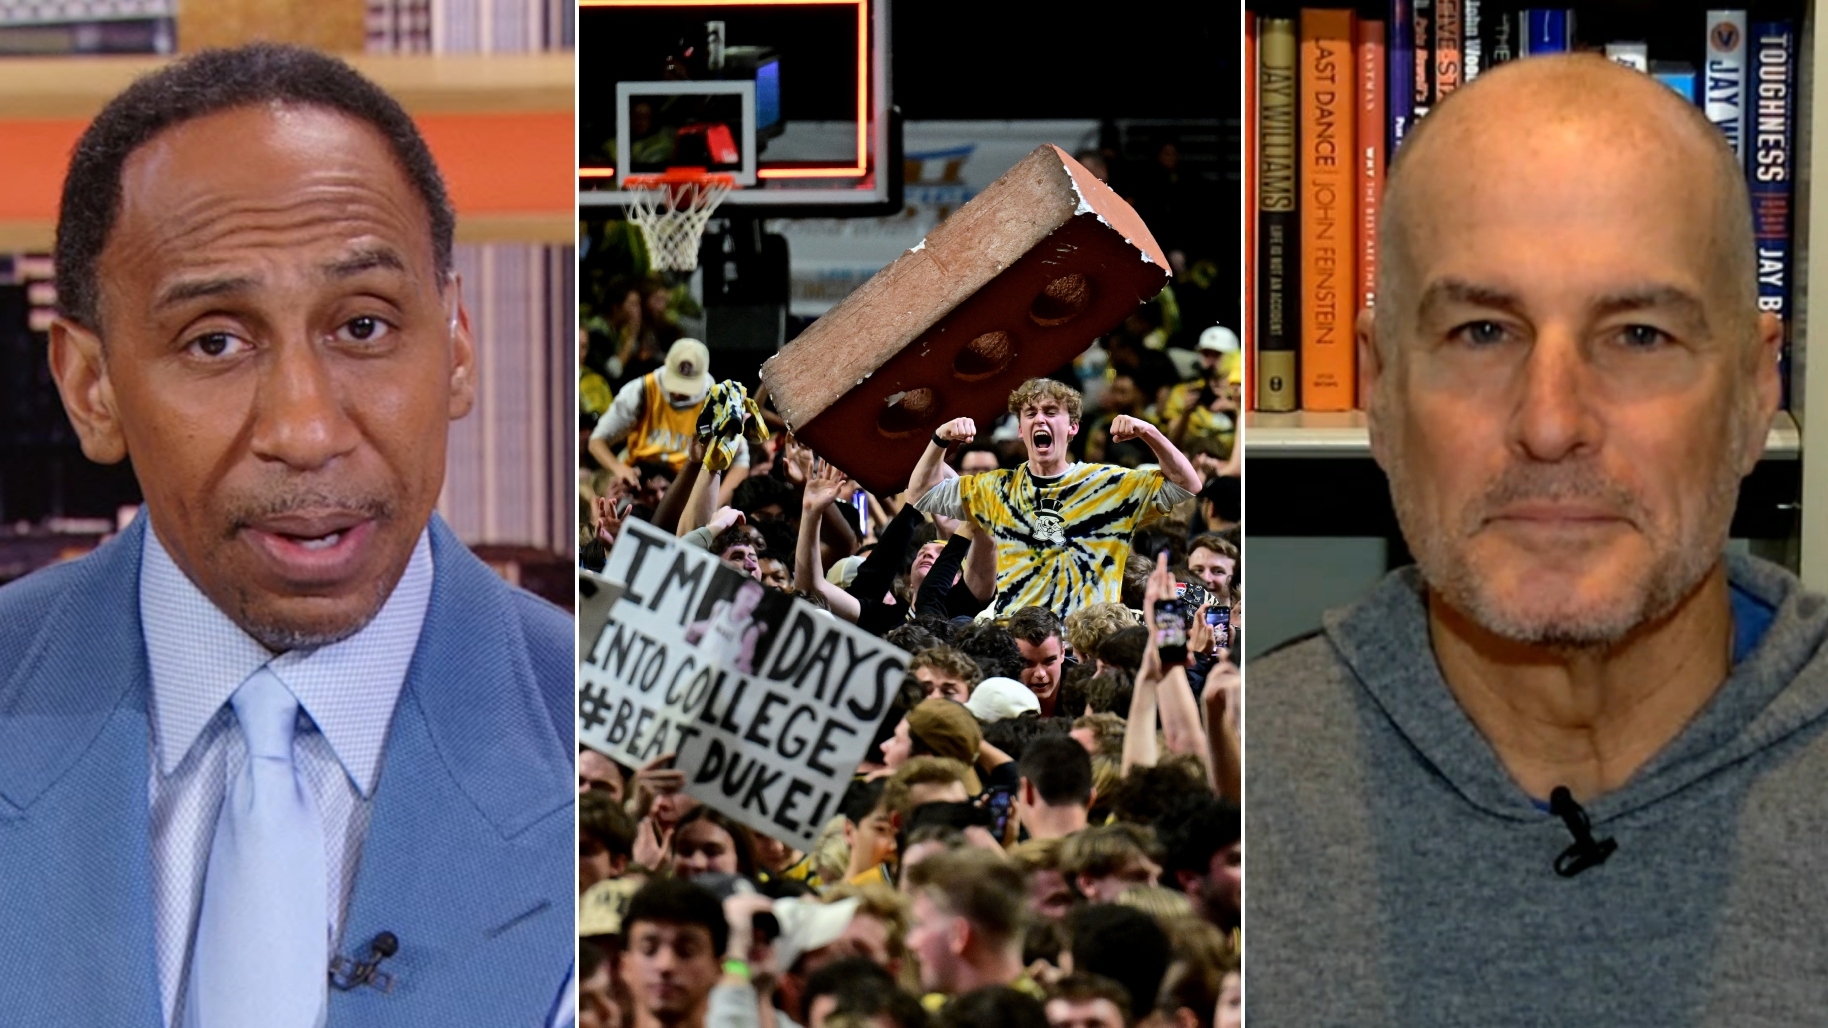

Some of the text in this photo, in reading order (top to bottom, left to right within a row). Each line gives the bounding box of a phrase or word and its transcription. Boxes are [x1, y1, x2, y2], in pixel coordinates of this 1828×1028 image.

[1709, 60, 1739, 107] JAY
[1757, 32, 1788, 182] TOUGHNESS
[1262, 63, 1293, 209] JAY WILLIAMS
[1366, 146, 1375, 177] WHY
[1312, 37, 1336, 345] LAST DANCE JOHN FEINSTEIN
[1366, 181, 1375, 202] THE
[1366, 208, 1375, 236] BEST
[1366, 240, 1375, 261] ARE
[1758, 248, 1784, 286] JAY
[585, 619, 856, 777] INTO COLLEGE
[768, 610, 905, 722] DAYS
[579, 682, 833, 839] #BEAT DUKE!
